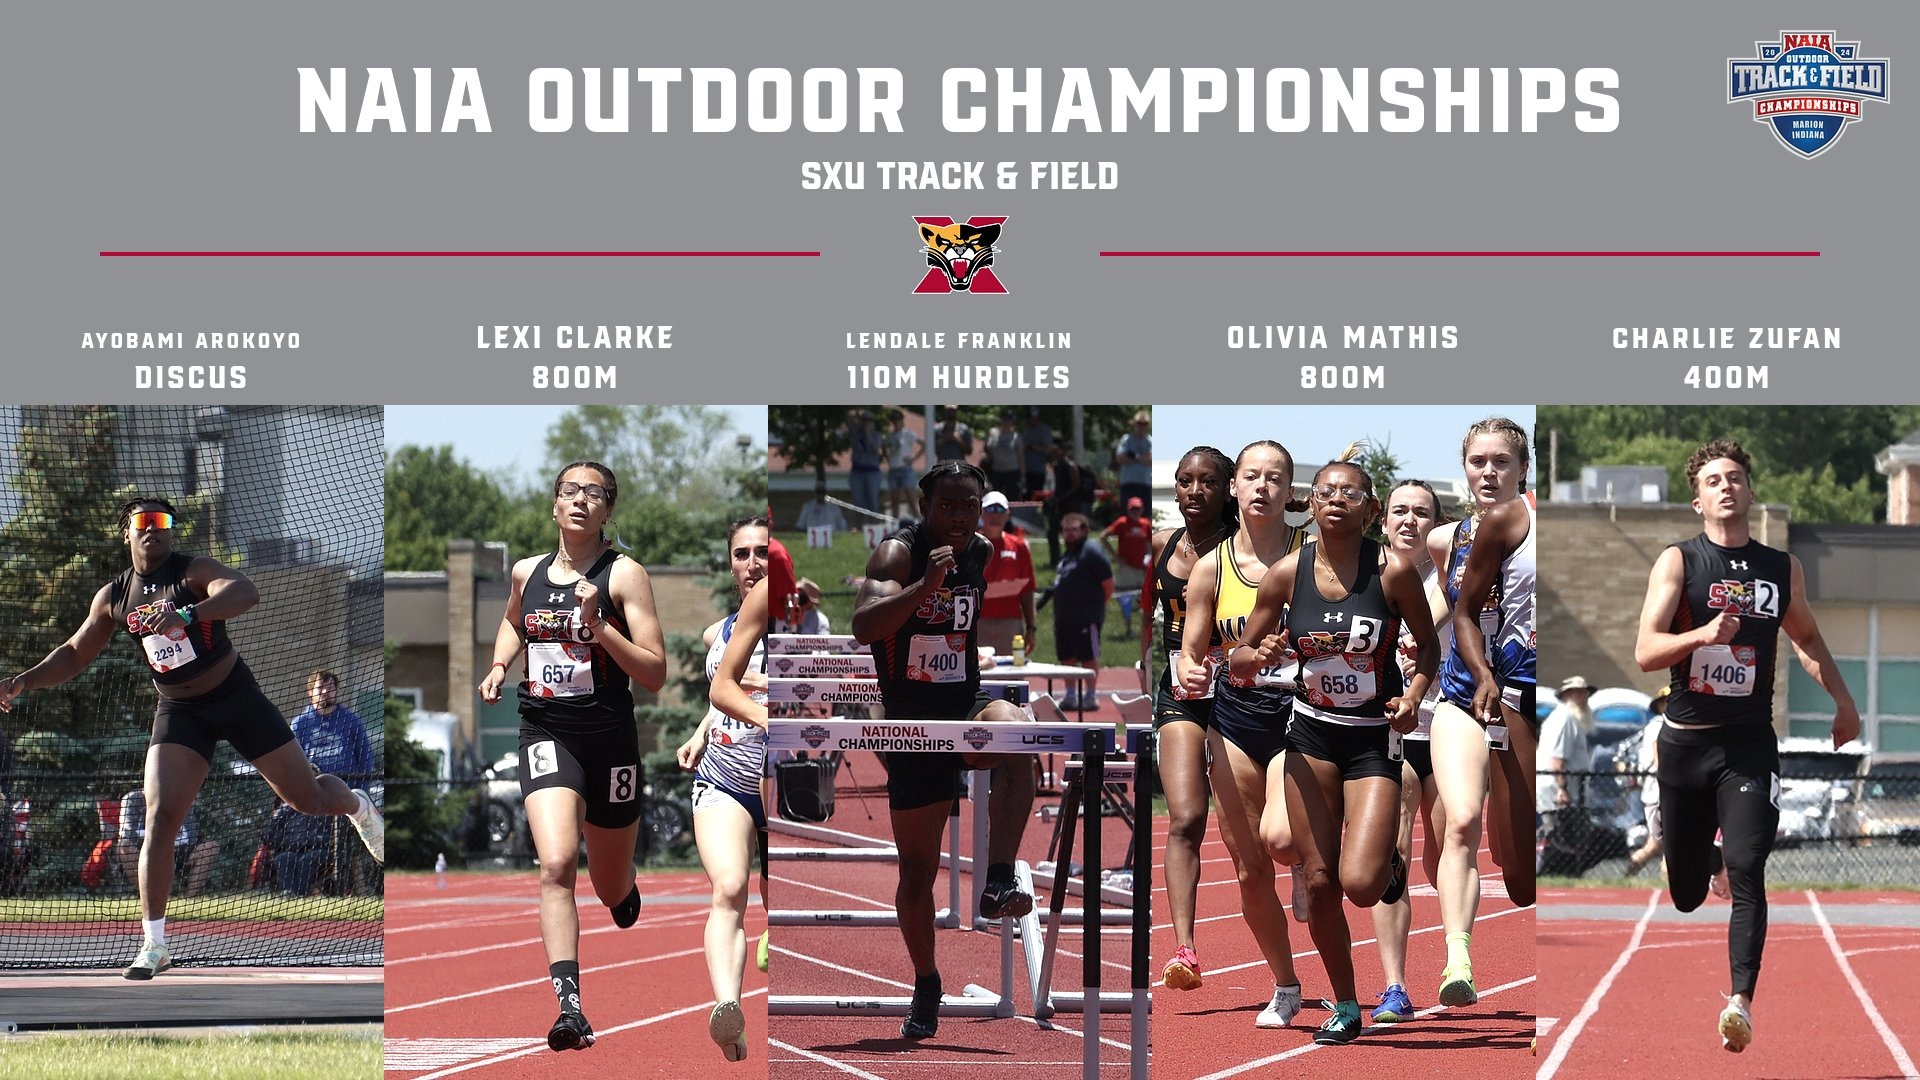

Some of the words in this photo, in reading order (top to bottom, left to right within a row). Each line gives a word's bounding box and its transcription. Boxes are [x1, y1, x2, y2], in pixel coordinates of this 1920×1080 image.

[1760, 582, 1774, 613] 2
[957, 598, 970, 629] 3
[1352, 620, 1375, 653] 3
[154, 643, 183, 662] 2294
[784, 644, 844, 652] CHAMPIONSHIPS
[798, 666, 870, 674] CHAMPIONSHIPS
[812, 658, 854, 666] NATIONAL
[919, 652, 958, 672] 1400
[542, 664, 576, 684] 657
[1701, 663, 1747, 684] 1406
[838, 683, 882, 693] NATIONA
[1320, 674, 1359, 695] 658
[820, 692, 884, 703] CHAMPIONS
[861, 726, 929, 738] NATIONAL
[1022, 734, 1065, 745] UCS
[838, 738, 955, 751] CHAMPIONSHIPS
[533, 743, 551, 774] 8
[615, 768, 632, 801] 8
[815, 913, 852, 921] UCS
[836, 1000, 881, 1009] UCS
